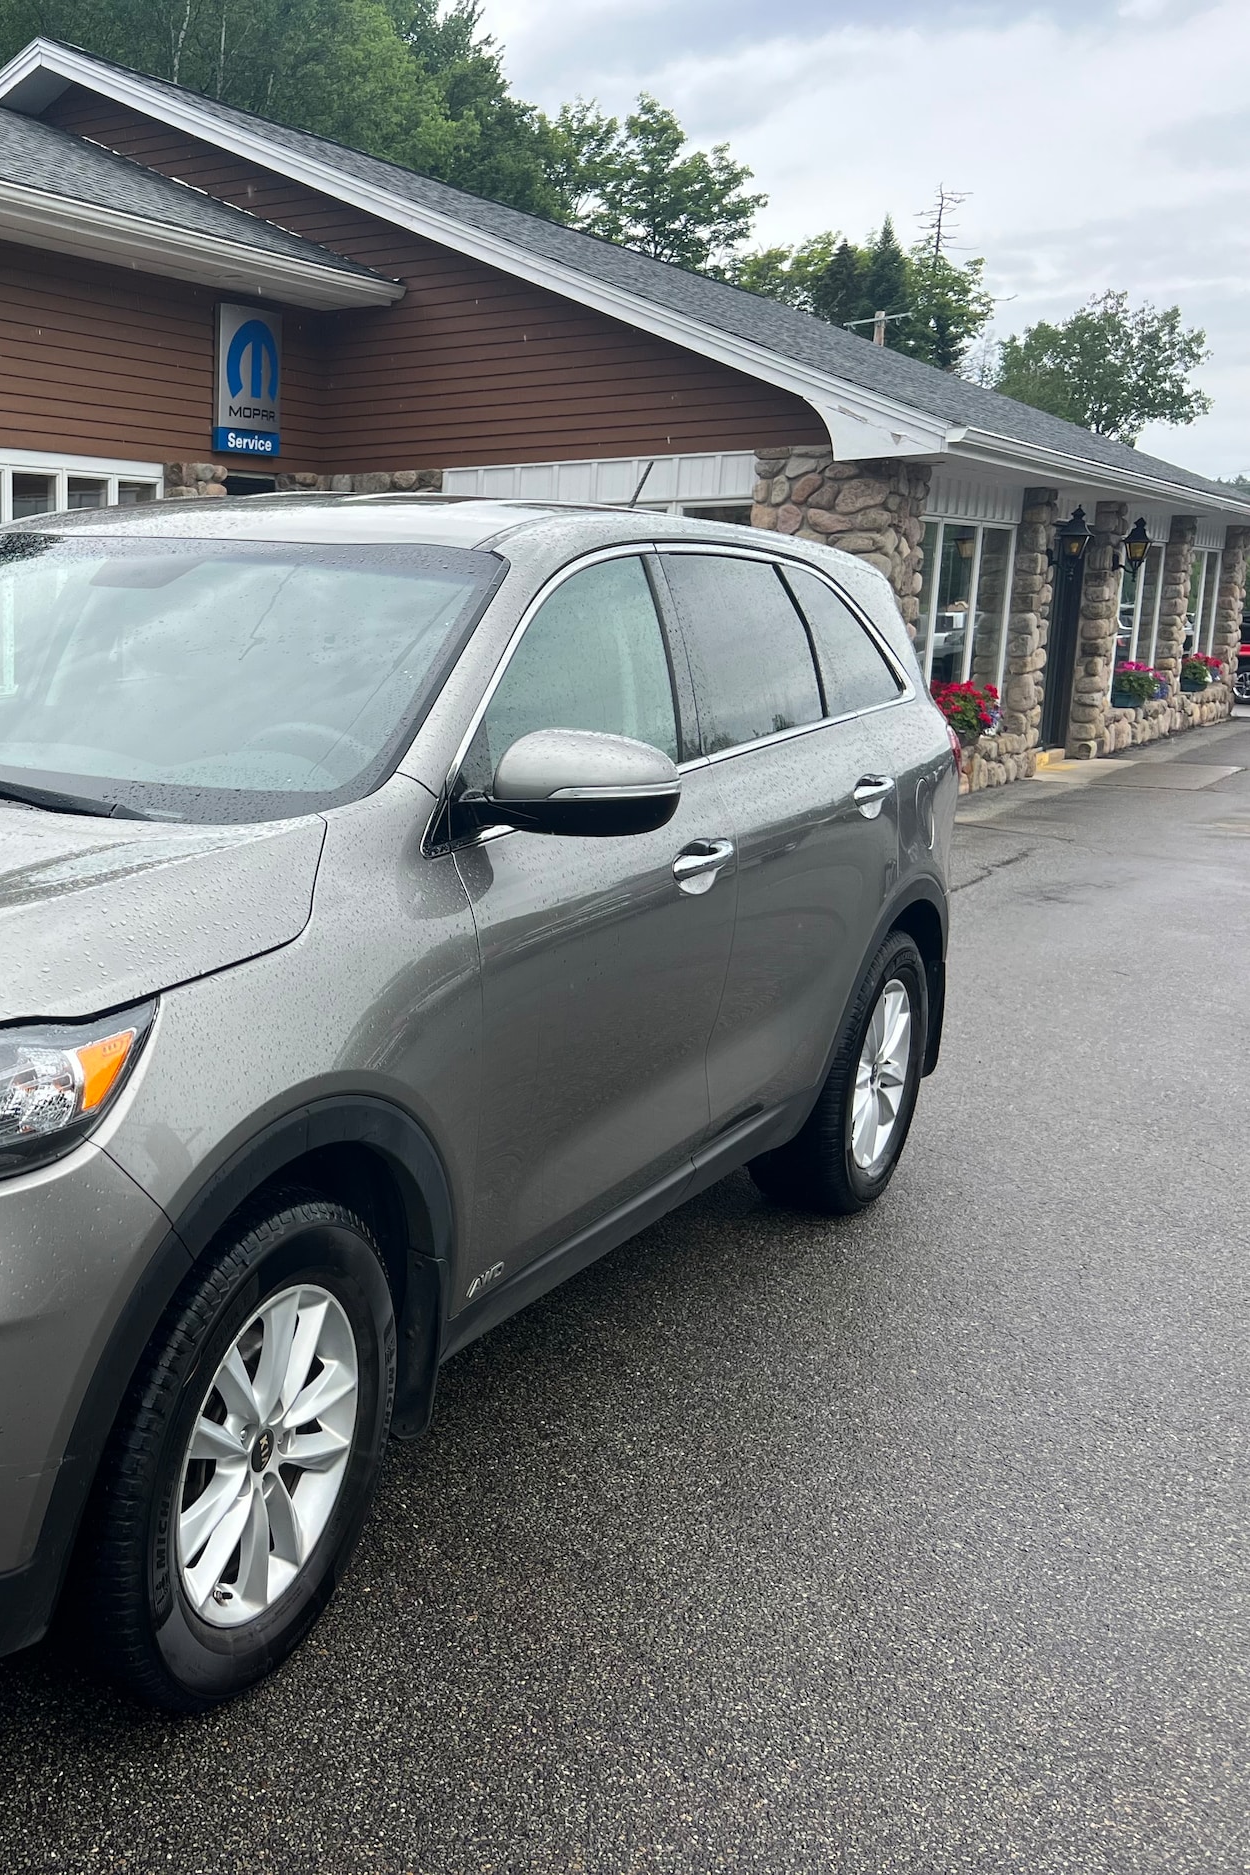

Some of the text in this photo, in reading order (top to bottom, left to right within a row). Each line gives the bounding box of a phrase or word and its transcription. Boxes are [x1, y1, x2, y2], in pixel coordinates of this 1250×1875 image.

[228, 405, 276, 422] MOPAR
[227, 432, 272, 452] Service
[260, 1434, 269, 1468] KIA
